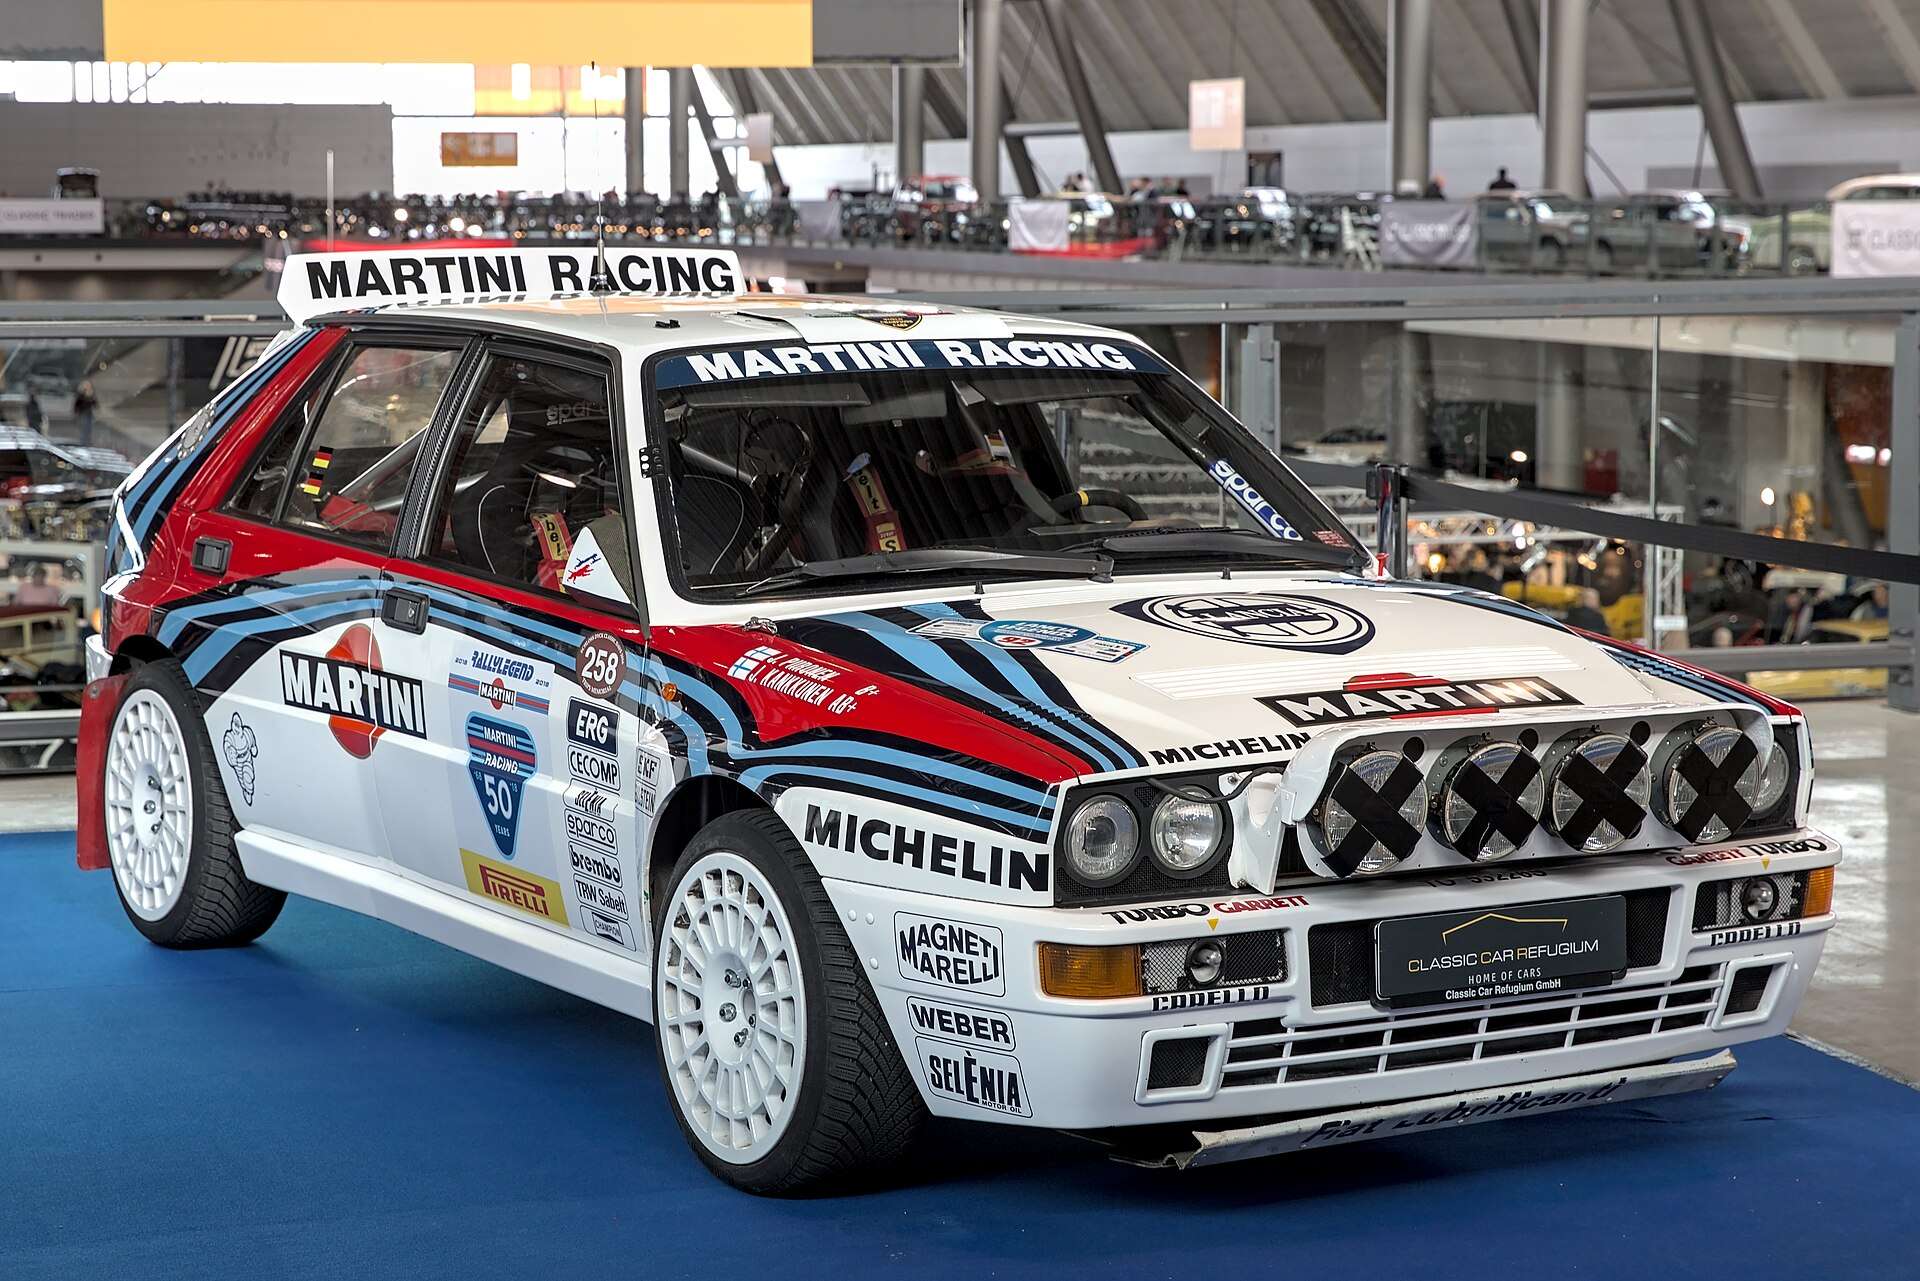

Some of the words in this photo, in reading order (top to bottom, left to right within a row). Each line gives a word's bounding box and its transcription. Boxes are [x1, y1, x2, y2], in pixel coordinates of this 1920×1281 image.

[306, 255, 527, 299] MARTINI
[548, 255, 735, 292] RACING
[686, 341, 925, 382] MARTINI
[933, 341, 1136, 371] RACING
[1214, 460, 1303, 541] sparco
[997, 636, 1036, 646] 92
[455, 657, 468, 665] 2018
[581, 646, 619, 685] 258
[282, 654, 424, 734] MARTINI
[480, 683, 515, 705] MARTINI
[535, 679, 550, 687] 2018
[748, 665, 766, 683] J.
[759, 667, 834, 706] KANKKUNEN
[827, 693, 857, 714] AB+
[854, 684, 880, 696] B+
[1276, 680, 1563, 722] MARTINI
[483, 726, 517, 748] MARTINI
[576, 710, 608, 744] ERG
[484, 752, 518, 774] RACING
[1152, 732, 1311, 766] MICHELIN
[570, 751, 617, 785] CECOMP
[637, 754, 658, 779] SKF
[484, 774, 512, 820] 50
[494, 824, 510, 837] YEARS
[567, 814, 615, 844] sparco
[804, 803, 1050, 892] MICHELIN
[1743, 838, 1828, 857] TURBO
[570, 848, 621, 883] brembo
[479, 864, 549, 916] PIRELLI
[575, 879, 599, 903] TRW
[600, 891, 627, 916] Sabelt
[1102, 903, 1210, 925] TURBO
[1214, 896, 1310, 914] GARRETT
[899, 923, 999, 961] MAGNETI
[1408, 953, 1478, 973] CLASSIC
[1480, 949, 1514, 965] CAR
[1516, 939, 1600, 961] REFUGIUM
[902, 944, 999, 985] MARELLI
[1468, 972, 1496, 985] HOME
[1501, 970, 1514, 981] OF
[1517, 967, 1541, 979] CARS
[1445, 988, 1477, 1000] Classic
[1478, 986, 1493, 997] Car
[1494, 981, 1534, 996] Refugium
[1535, 978, 1561, 990] GmbH
[911, 1003, 1010, 1044] WEBER
[929, 1049, 1021, 1108] SELÈNIA
[982, 1100, 1007, 1111] MOTOR
[1009, 1106, 1022, 1114] OIL
[1301, 1119, 1385, 1144] Fiat
